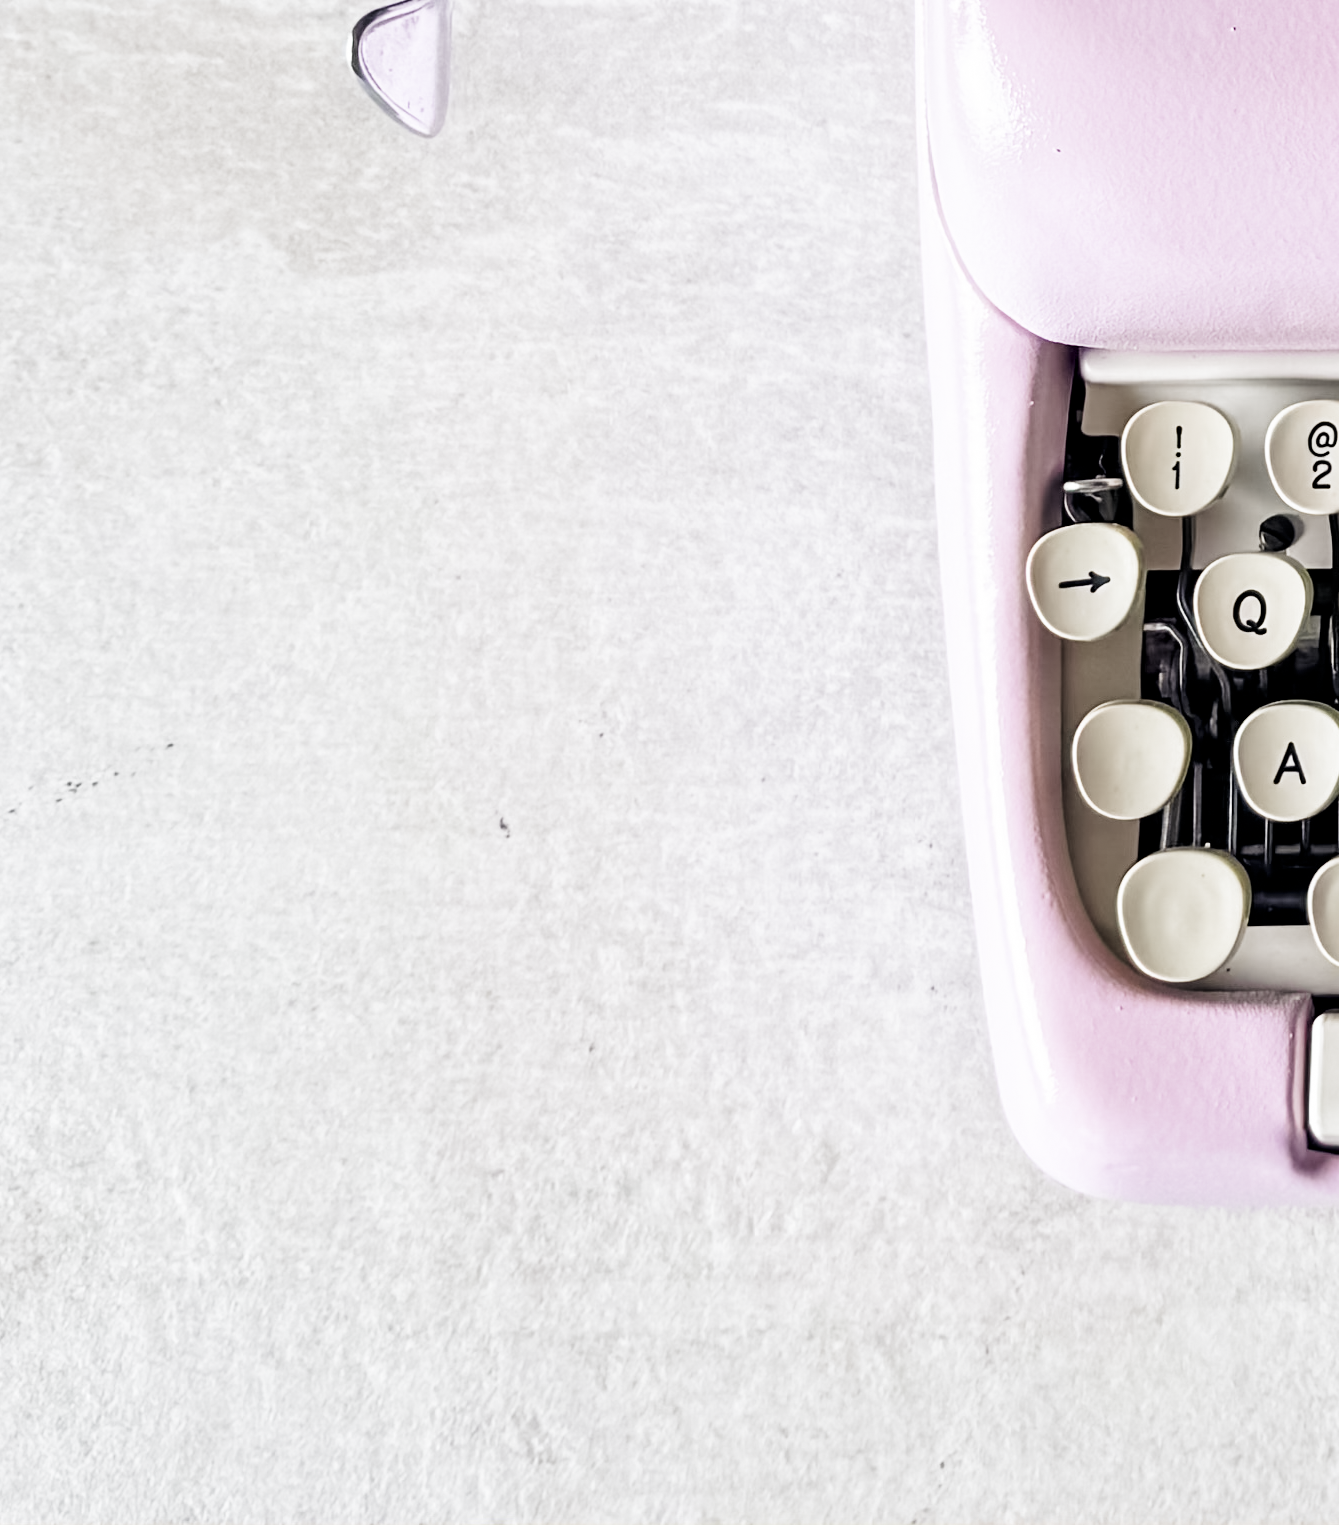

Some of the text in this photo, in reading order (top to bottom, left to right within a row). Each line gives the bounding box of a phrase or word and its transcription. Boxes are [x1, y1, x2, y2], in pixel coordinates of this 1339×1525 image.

[1175, 425, 1183, 458] !
[1307, 421, 1338, 458] @
[1170, 461, 1181, 490] 1
[1311, 459, 1332, 490] 2
[1232, 589, 1268, 636] Q
[1272, 741, 1307, 785] A
